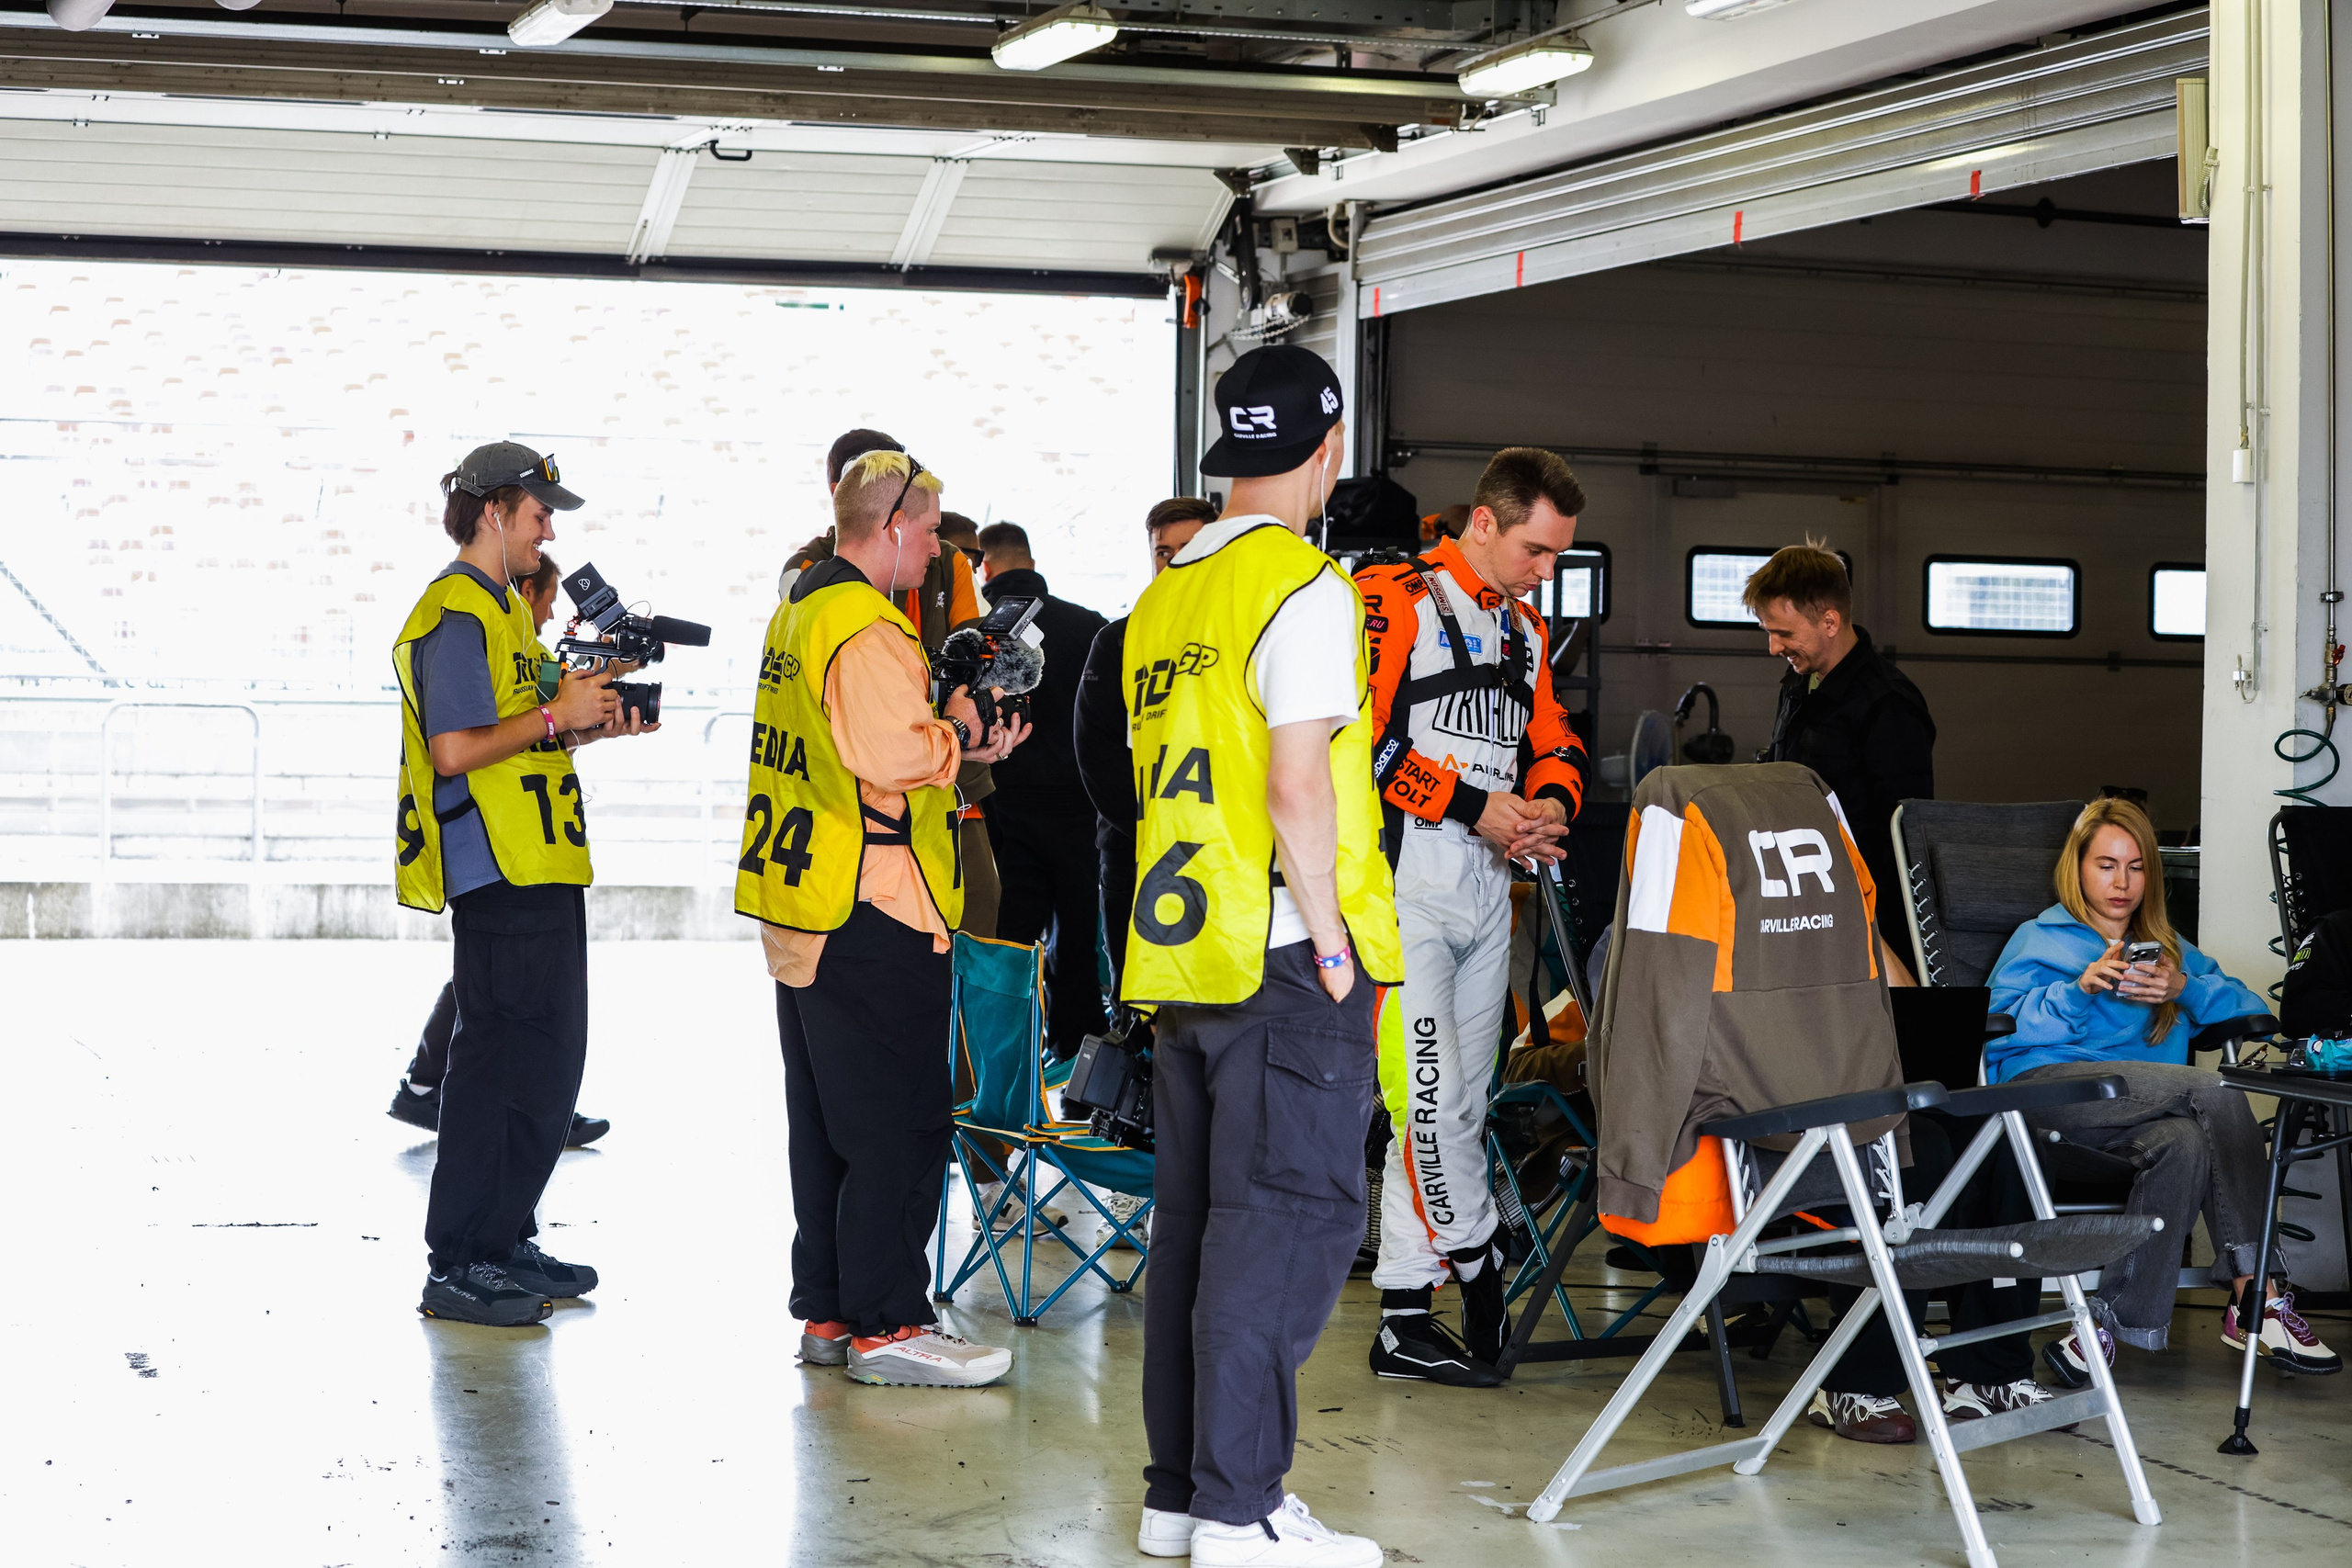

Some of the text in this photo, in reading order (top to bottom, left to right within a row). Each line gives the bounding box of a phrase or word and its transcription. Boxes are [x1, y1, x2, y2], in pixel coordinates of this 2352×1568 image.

[1320, 386, 1339, 414] 45
[1229, 405, 1277, 432] CR
[1404, 578, 1424, 594] OMP
[1428, 576, 1449, 612] SIMPSON
[1364, 594, 1383, 614] R
[784, 653, 801, 682] GP
[1146, 708, 1167, 720] DRIF
[750, 721, 810, 783] EDIA
[520, 773, 586, 847] 13
[1415, 817, 1443, 829] OMP
[739, 793, 814, 888] 24
[1748, 829, 1835, 897] CR
[1134, 840, 1207, 946] 6
[1760, 918, 1794, 933] ARVILLE
[1414, 1017, 1454, 1225] CARVILLE RACING
[446, 1285, 477, 1302] ALTRA
[893, 1346, 943, 1363] ALTRA
